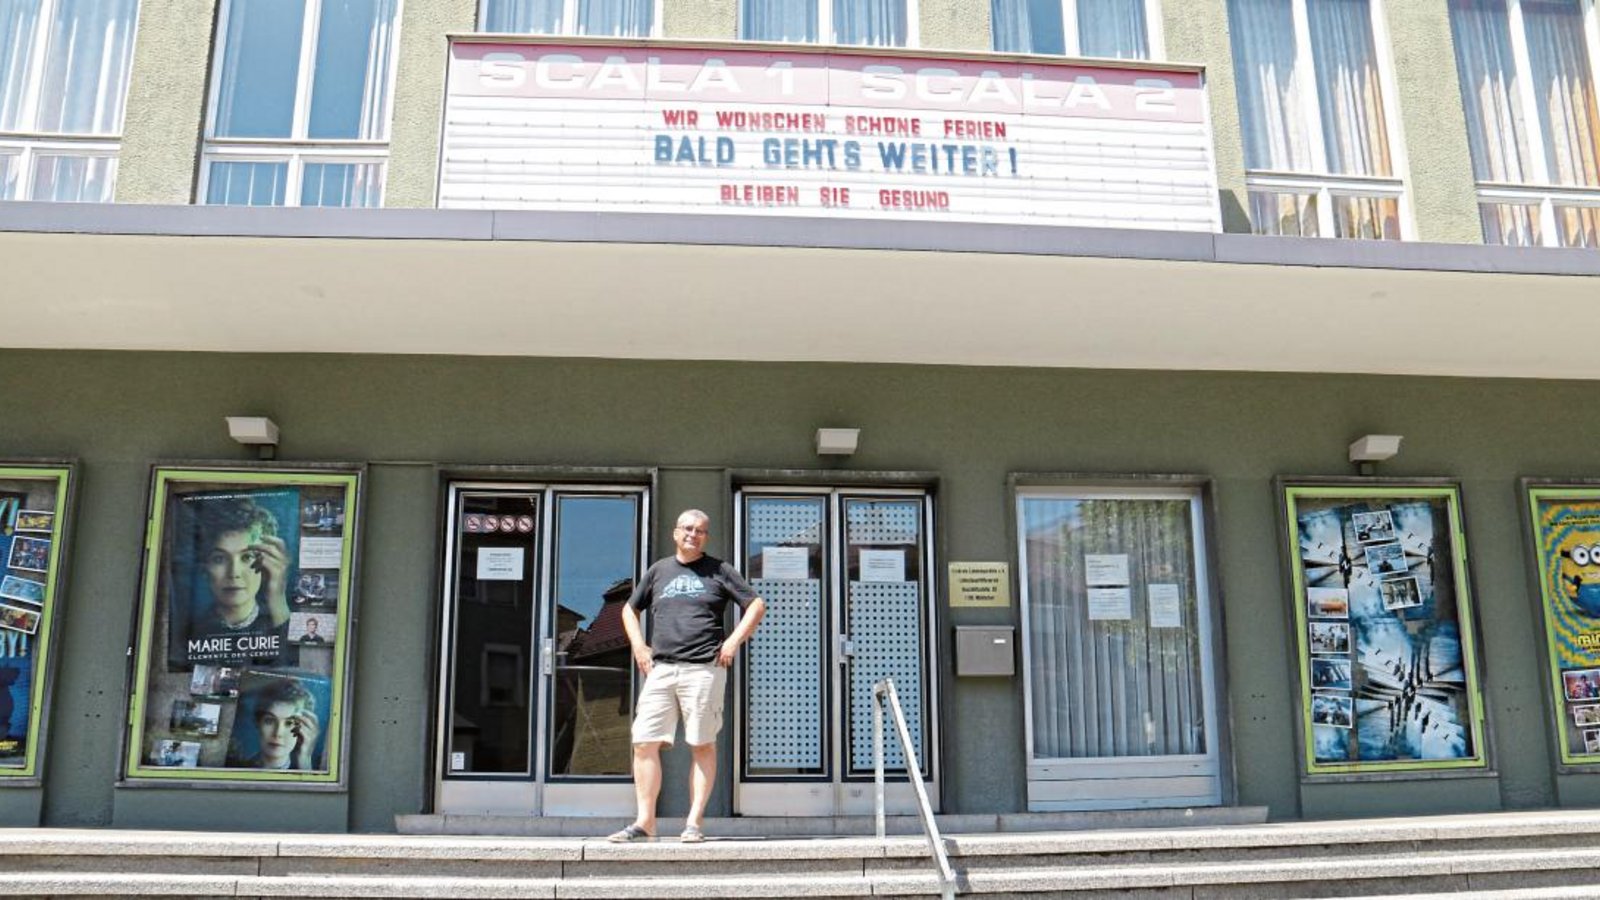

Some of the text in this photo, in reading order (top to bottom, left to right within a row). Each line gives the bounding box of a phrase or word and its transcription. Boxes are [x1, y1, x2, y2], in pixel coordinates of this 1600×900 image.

[479, 52, 796, 96] SCALA 1
[861, 64, 1177, 112] SCALA 2
[662, 109, 699, 127] WIR
[943, 119, 1007, 139] FERIEN
[654, 134, 736, 165] BALD
[720, 184, 950, 209] BLEIBEN SIE GESUND
[187, 635, 280, 653] MARIE CURIE
